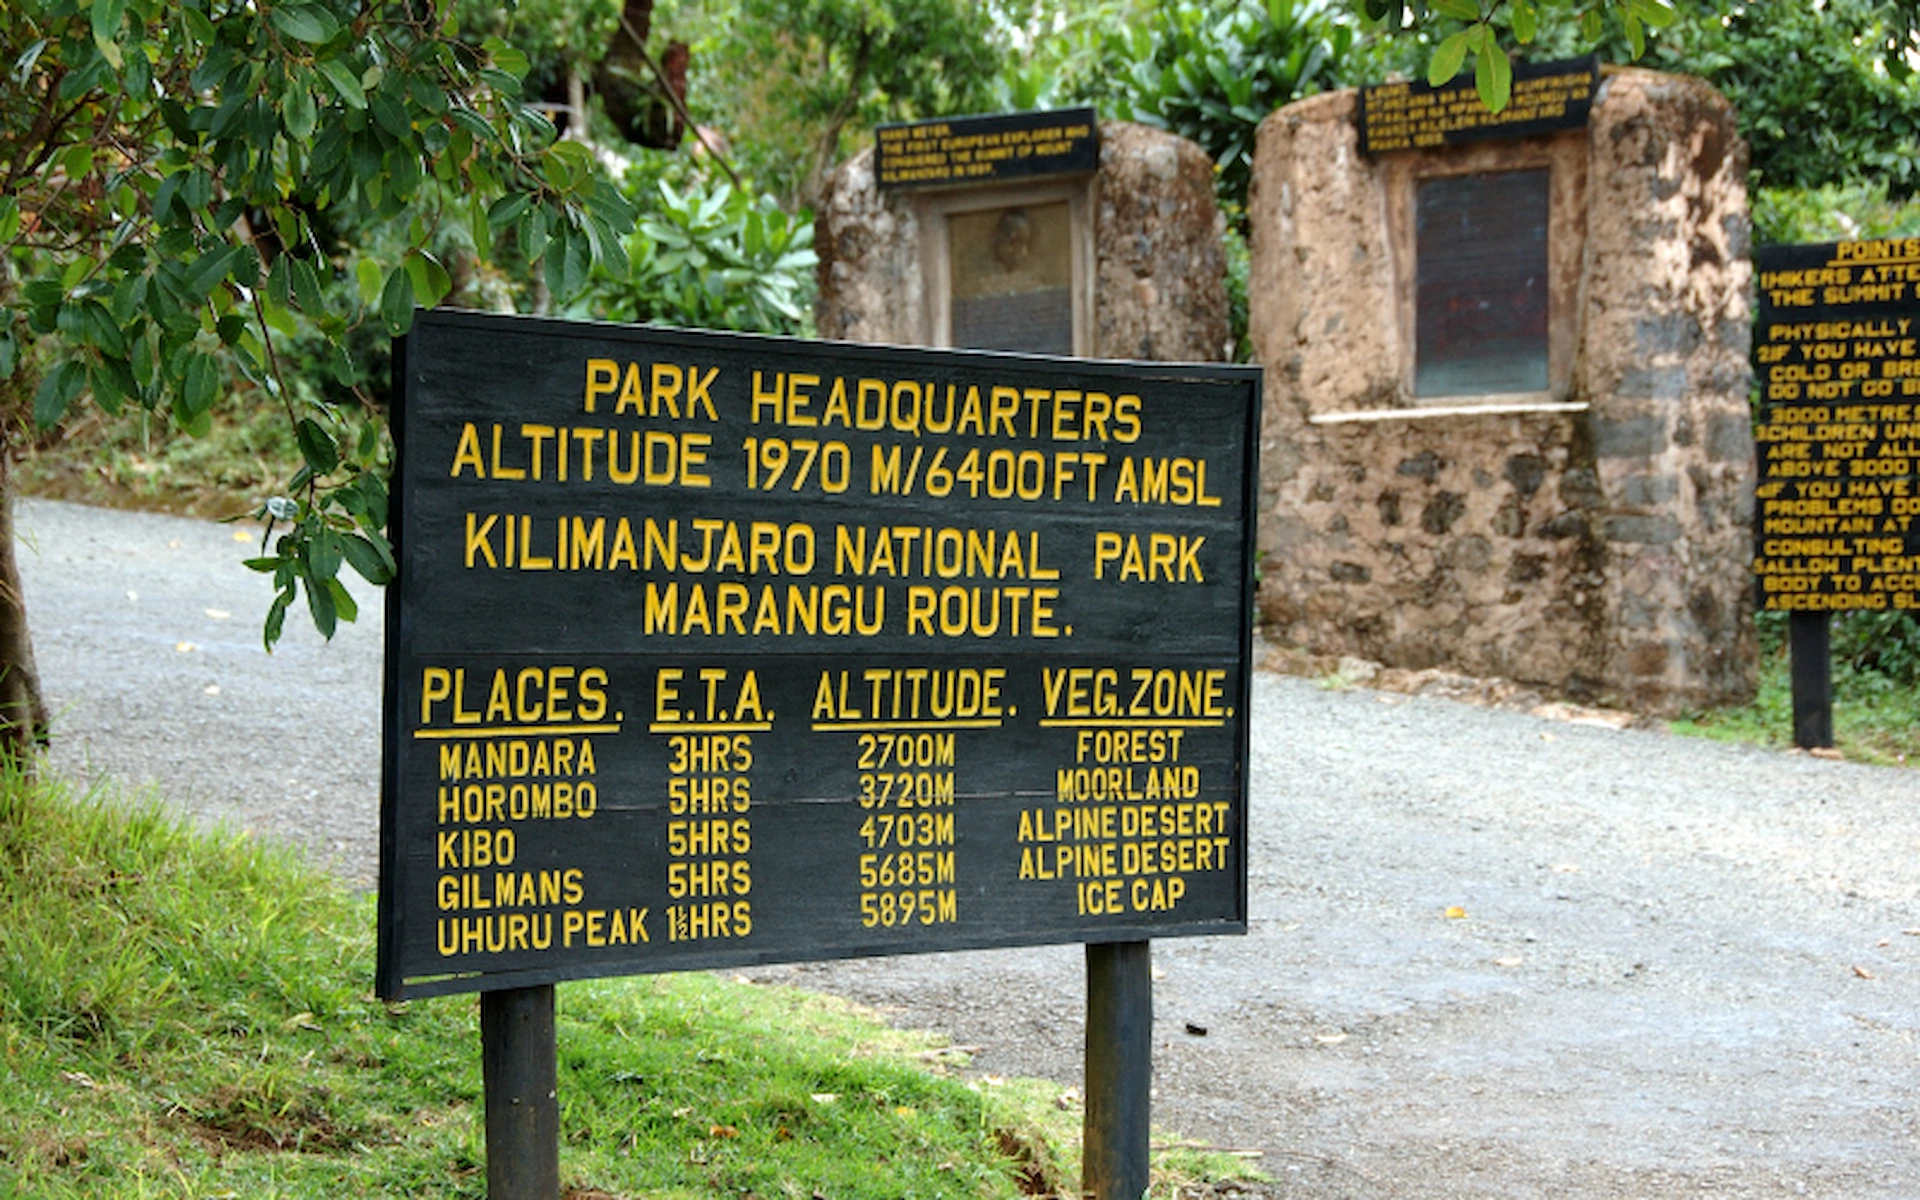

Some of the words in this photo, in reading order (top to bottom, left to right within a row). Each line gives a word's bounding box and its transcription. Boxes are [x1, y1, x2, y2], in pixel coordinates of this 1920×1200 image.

[1837, 240, 1920, 260] POINTS
[1769, 290, 1815, 307] THE
[1823, 284, 1906, 305] SUMMIT
[1769, 319, 1913, 342] PHYSICALLY
[1799, 344, 1847, 360] YOU
[1853, 340, 1917, 358] HAVE
[1769, 365, 1832, 382] COLD
[1838, 363, 1870, 379] OR
[1768, 384, 1801, 400] DO
[1806, 382, 1855, 399] NOT
[1861, 381, 1893, 398] GO
[1902, 380, 1920, 396] B
[584, 358, 720, 421] PARK
[751, 370, 1143, 443] HEADQUARTERS
[1770, 408, 1830, 424] 3000
[1884, 424, 1920, 441] UN
[1766, 445, 1812, 460] ARE
[1822, 443, 1869, 459] NOT
[450, 422, 713, 487] ALTITUDE
[742, 437, 851, 494] 1970
[1053, 451, 1107, 502] FT
[1115, 456, 1222, 507] AMSL
[1767, 461, 1841, 478] ABOVE
[1794, 482, 1841, 498] YOU
[1848, 480, 1910, 497] HAVE
[1763, 499, 1883, 517] PROBLEMS
[1763, 518, 1875, 535] MOUNTAIN
[1882, 517, 1912, 533] AT
[465, 512, 815, 575] KILIMANJARO
[835, 524, 1060, 580] NATIONAL
[1094, 531, 1205, 583] PARK
[1763, 538, 1904, 557] CONSULTING
[1763, 577, 1823, 593] BODY
[1830, 576, 1862, 591] TO
[644, 582, 885, 636] MARANGU
[907, 585, 1073, 637] ROUTE.
[1764, 593, 1887, 611] ASCENDING
[421, 666, 623, 724] PLACES.
[656, 668, 775, 722] E.T.A.
[812, 668, 1017, 721] ALTITUDE.
[439, 738, 596, 780] MANDARA
[668, 734, 753, 774] 3HRS
[857, 733, 956, 770] 2700M
[1076, 729, 1184, 763] FOREST
[437, 781, 597, 824] HOROMBO
[668, 776, 751, 815] 5HRS
[858, 772, 956, 809] 3720M
[1057, 765, 1200, 802] MOORLAND
[437, 828, 515, 869] KIBO
[668, 817, 751, 857] 5HRS
[859, 812, 956, 848] 4703M
[1017, 805, 1117, 842] ALPINE
[1122, 802, 1230, 837] DESERT
[437, 868, 584, 911] GILMANS
[668, 860, 752, 898] 5HRS
[860, 850, 956, 888] 5685M
[1019, 842, 1118, 880] ALPINE
[1122, 837, 1230, 876] DESERT
[437, 911, 552, 956] UHURU
[562, 907, 650, 947] PEAK
[860, 888, 957, 928] 5895M
[1077, 880, 1125, 915] ICE
[1131, 876, 1187, 911] CAP
